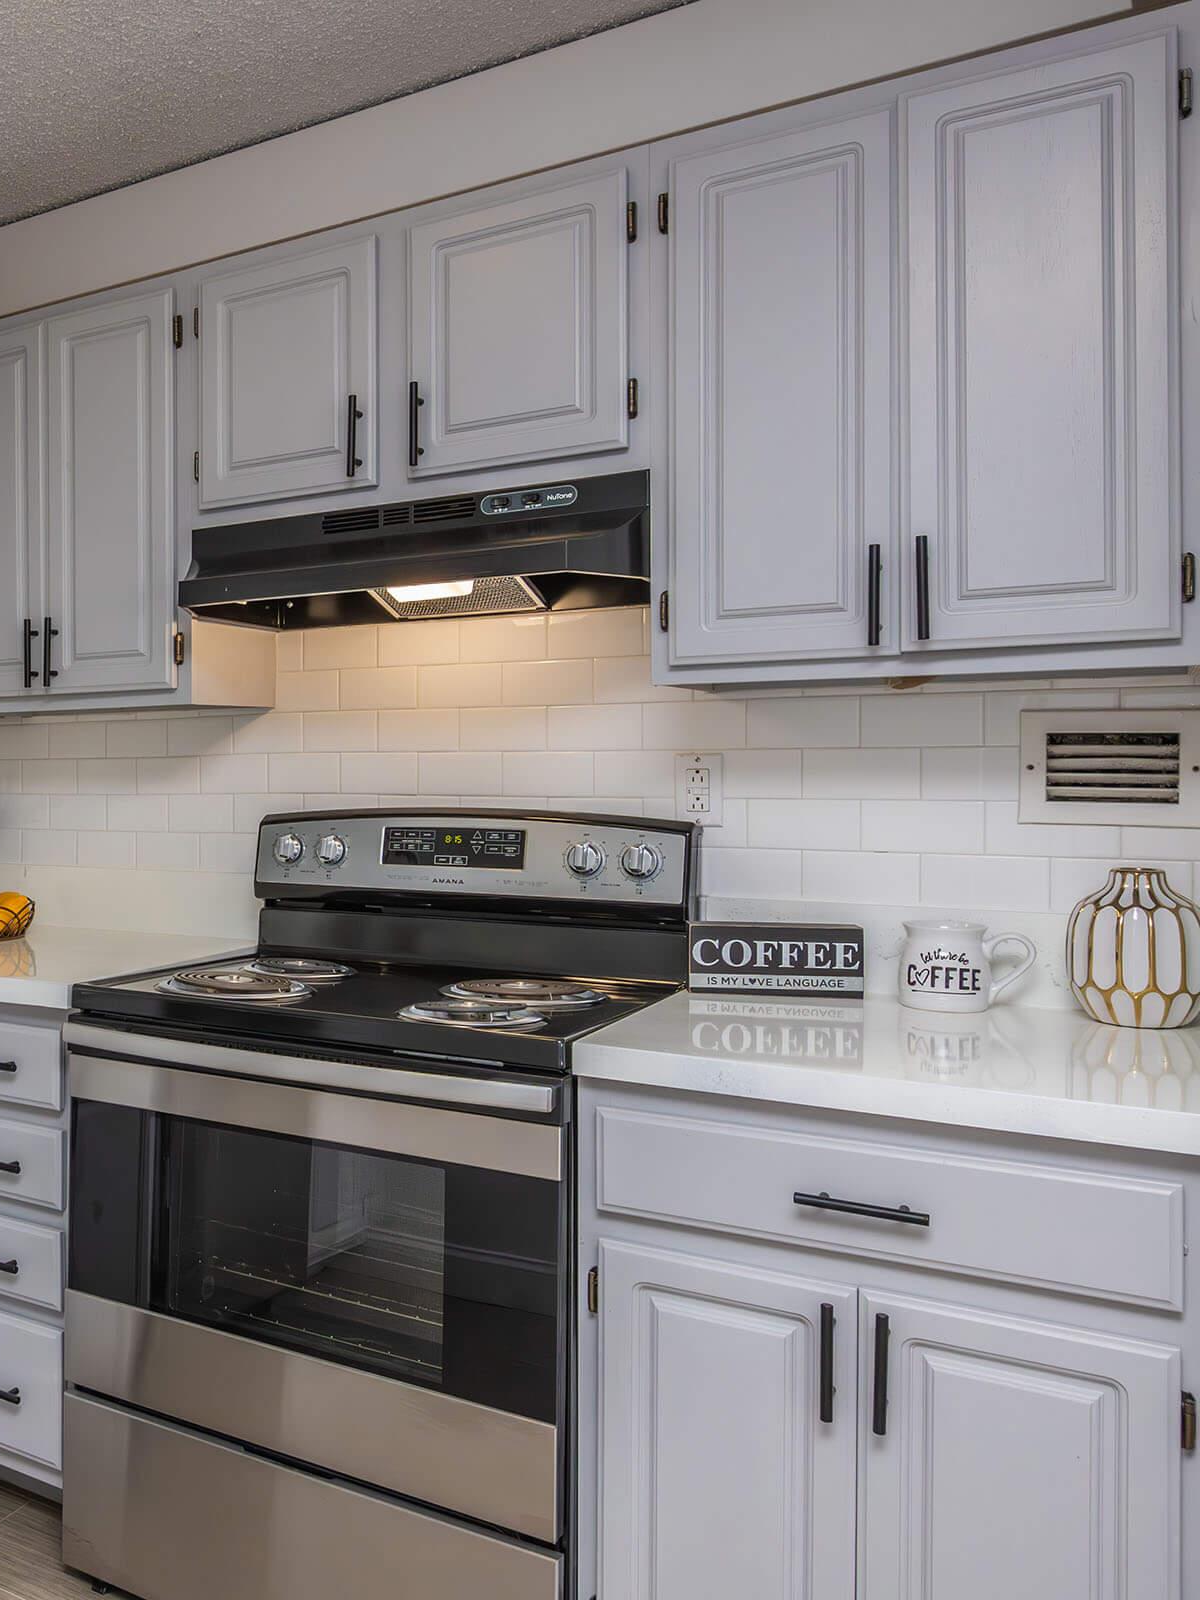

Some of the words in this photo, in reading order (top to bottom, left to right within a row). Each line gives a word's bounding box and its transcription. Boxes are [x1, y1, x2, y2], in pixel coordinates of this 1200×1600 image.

[546, 492, 573, 501] NuTone
[692, 938, 861, 970] COFFEE
[707, 976, 718, 985] IS
[721, 977, 739, 986] MY
[776, 978, 845, 988] LANGUAGE
